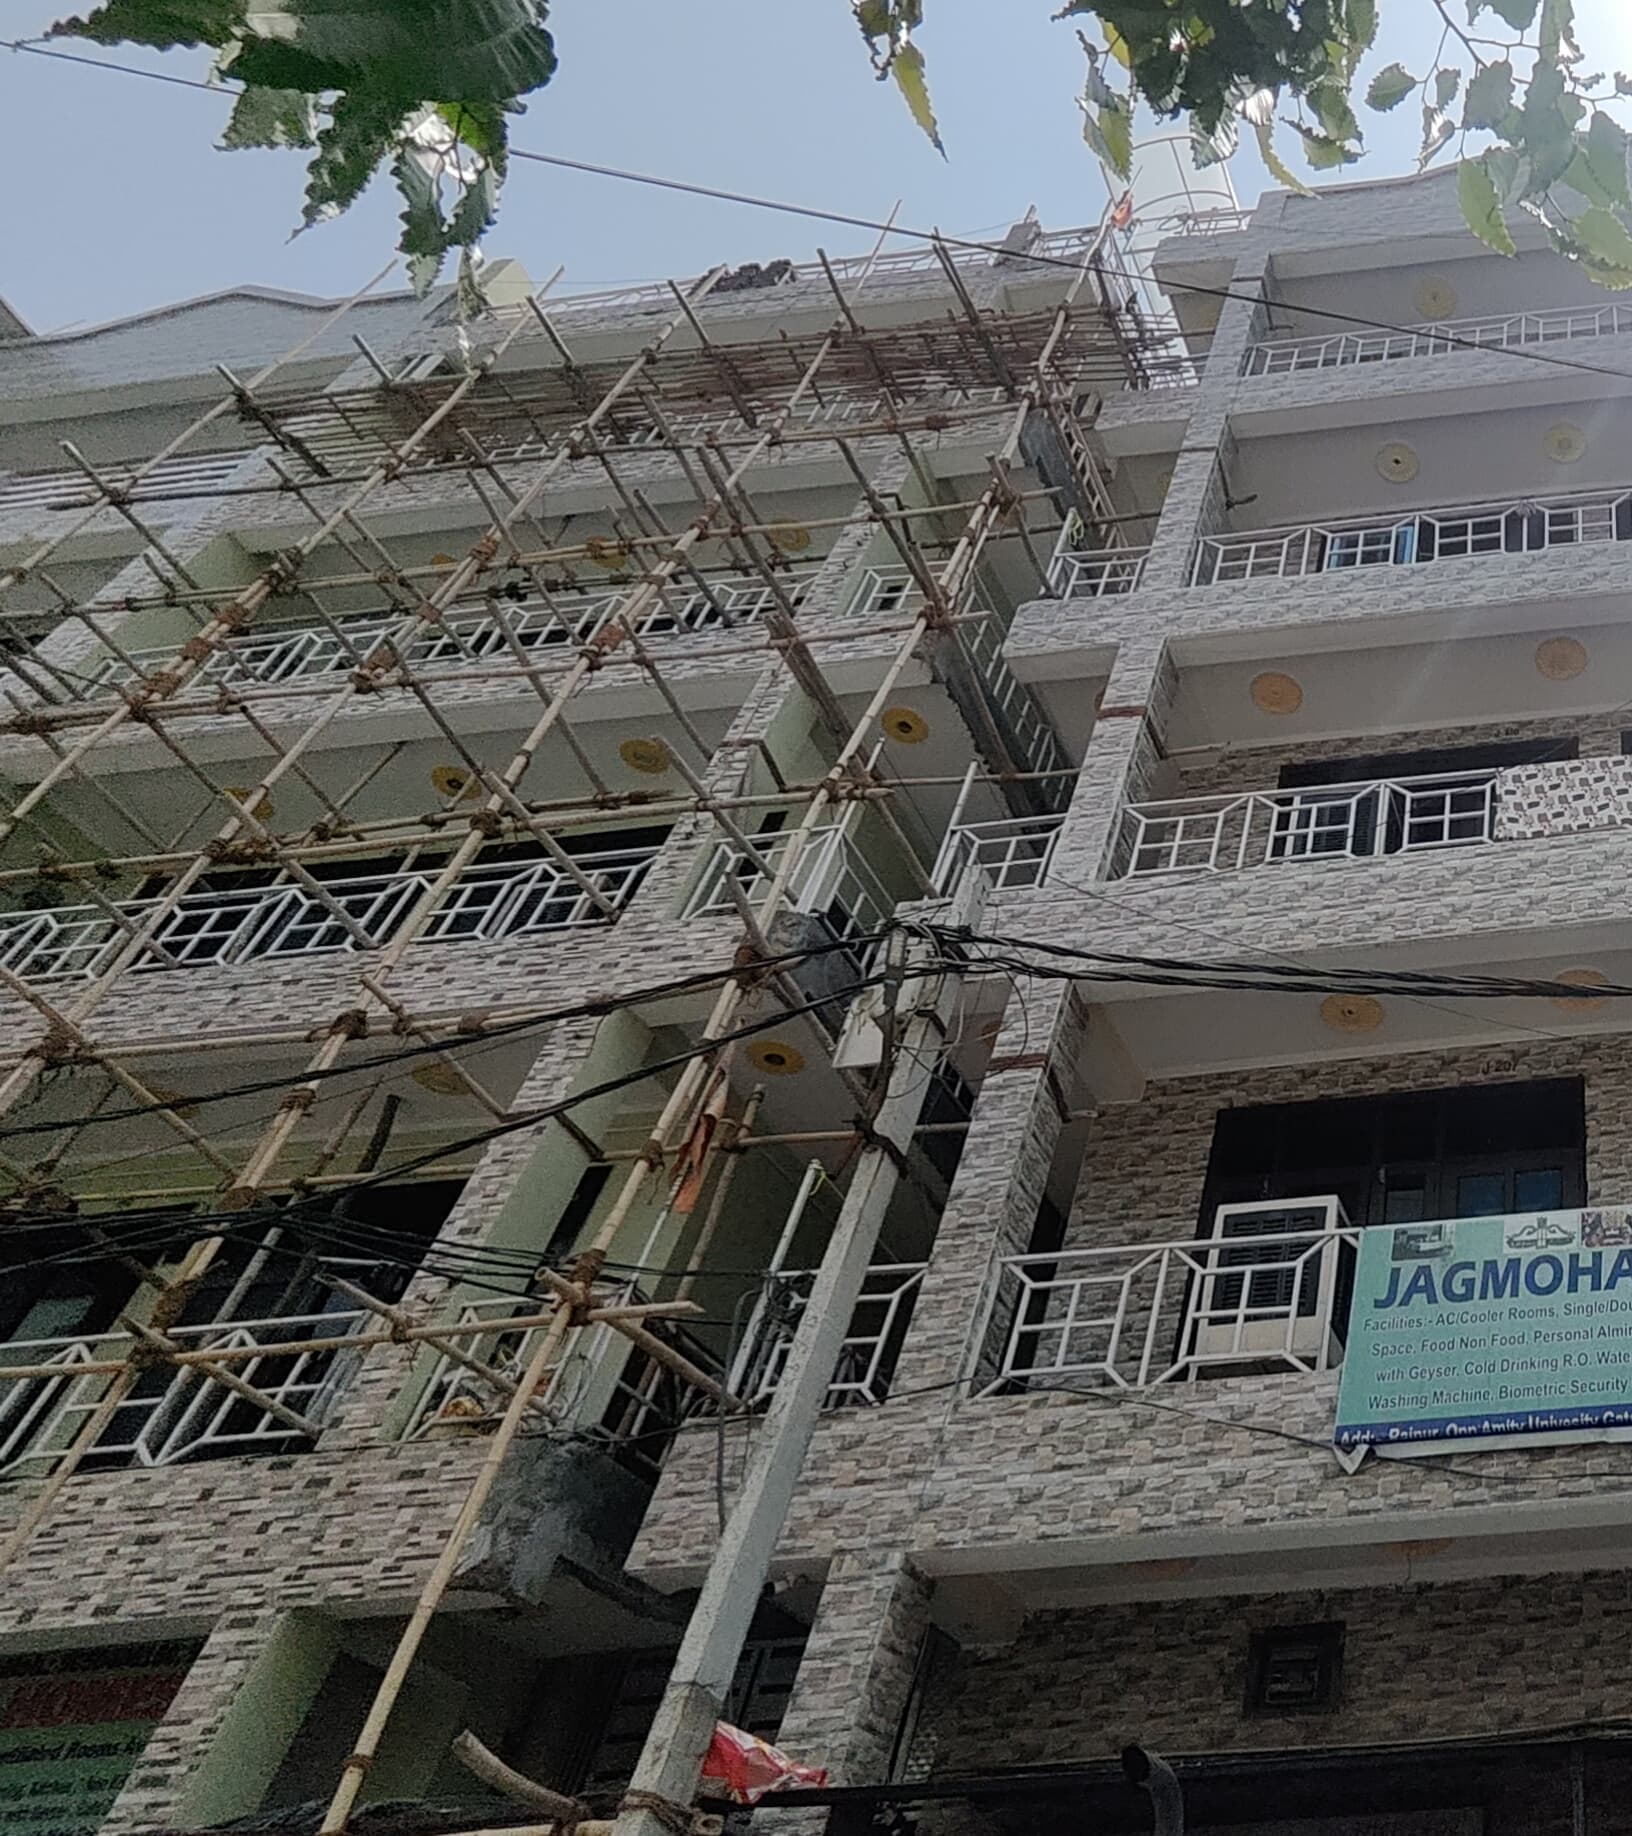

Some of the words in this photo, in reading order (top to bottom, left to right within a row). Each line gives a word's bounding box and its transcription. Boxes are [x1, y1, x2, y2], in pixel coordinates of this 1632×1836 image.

[1421, 1338, 1455, 1353] Food
[1460, 1336, 1487, 1350] Non
[1534, 1328, 1593, 1344] Personal
[1376, 1368, 1404, 1382] with
[1464, 1360, 1496, 1375] Cold
[1500, 1355, 1559, 1373] Drinking
[1368, 1393, 1427, 1410] Washing
[1499, 1382, 1565, 1400] Biometric
[1570, 1377, 1628, 1395] Security
